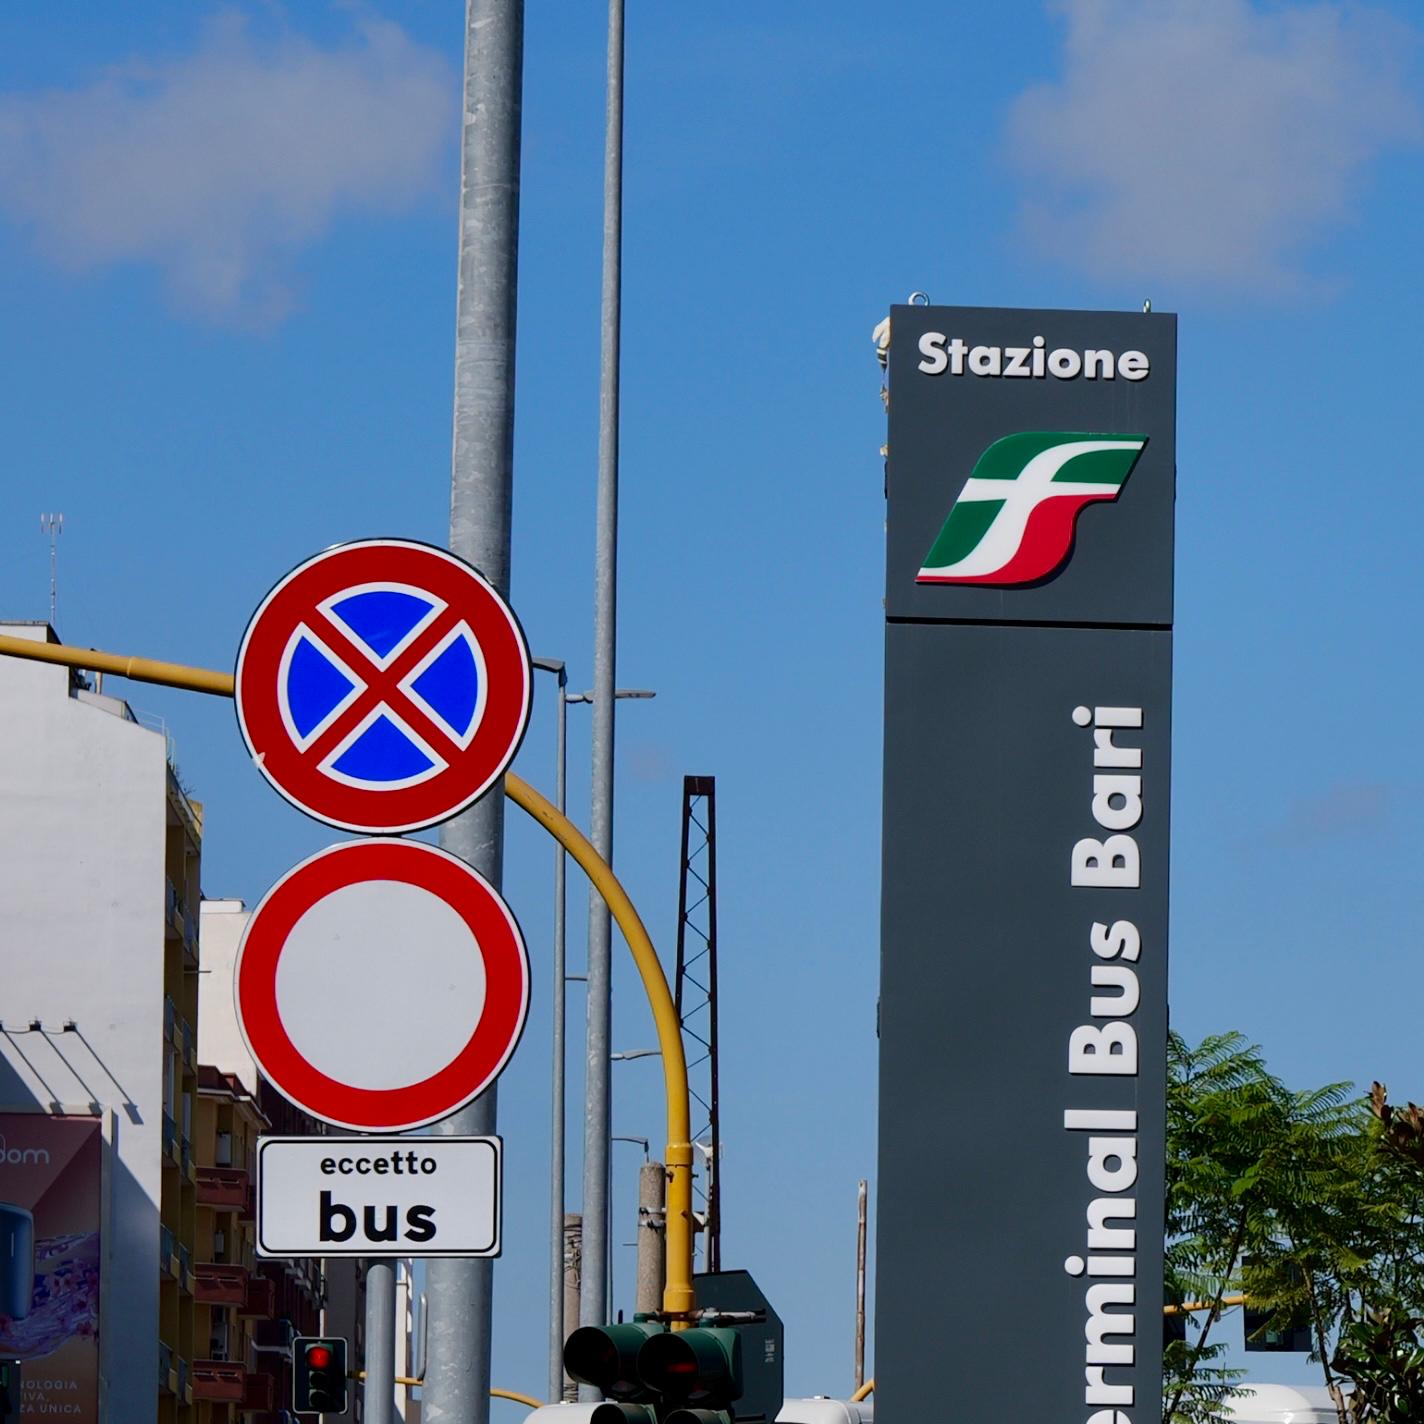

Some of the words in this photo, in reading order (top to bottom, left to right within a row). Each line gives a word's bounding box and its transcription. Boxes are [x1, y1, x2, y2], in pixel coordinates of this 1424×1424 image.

[918, 331, 1150, 381] Stazione
[1070, 705, 1144, 889] Bari
[1068, 919, 1142, 1076] Bus
[320, 1151, 438, 1175] eccetto
[319, 1190, 438, 1243] bus
[40, 1404, 82, 1414] UNICA
